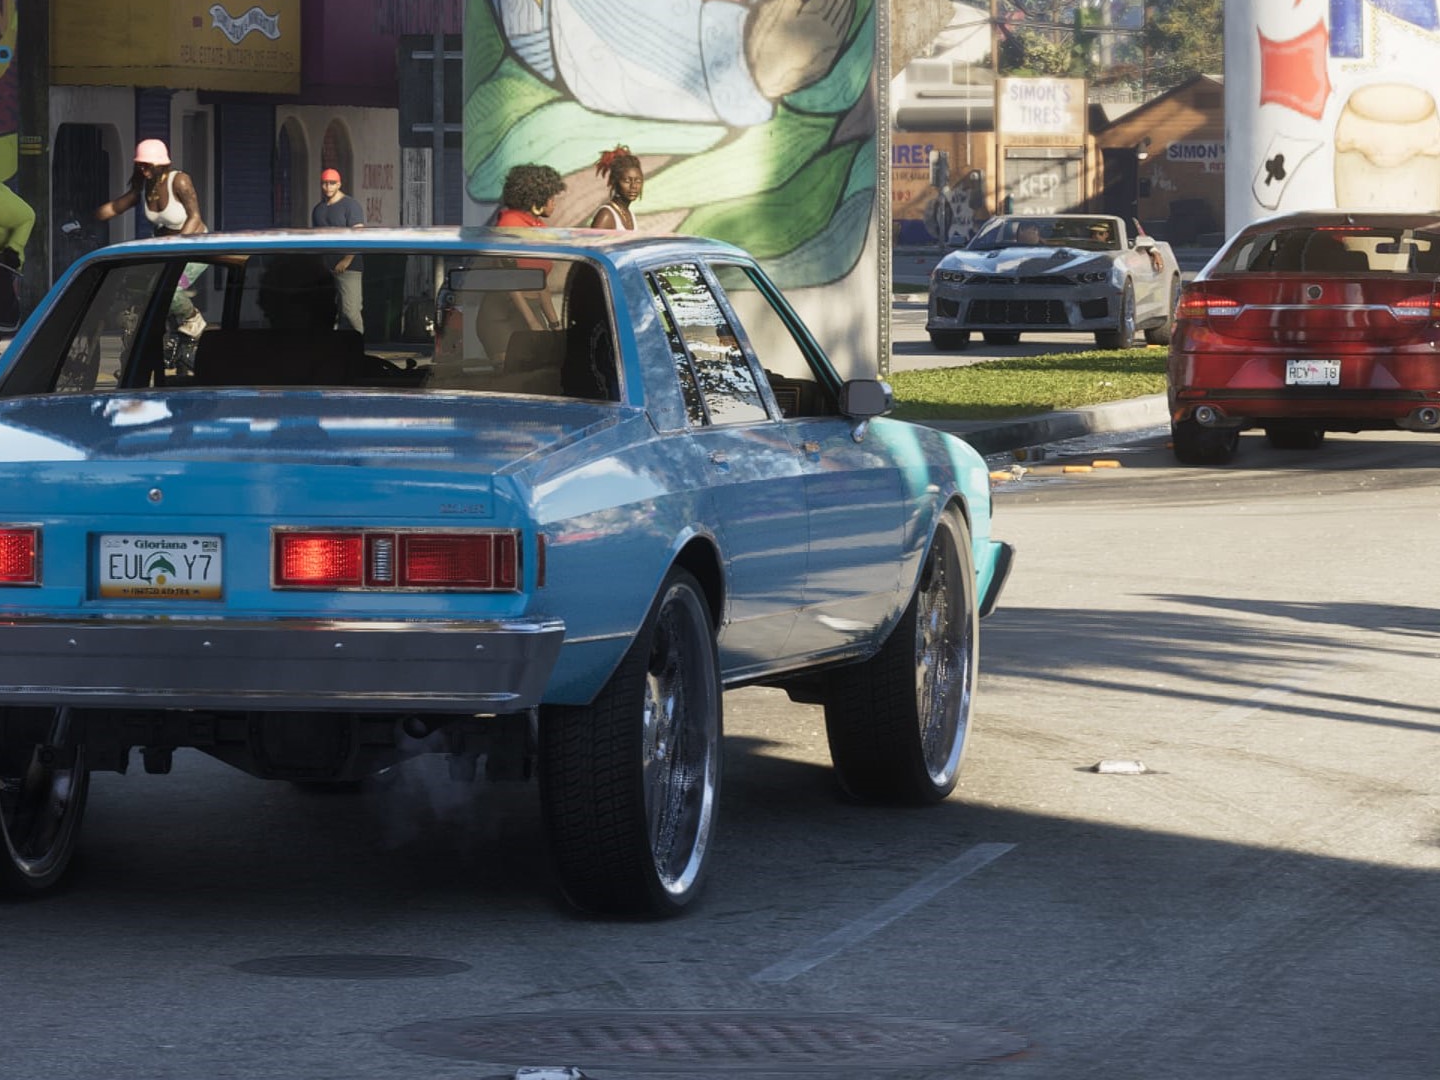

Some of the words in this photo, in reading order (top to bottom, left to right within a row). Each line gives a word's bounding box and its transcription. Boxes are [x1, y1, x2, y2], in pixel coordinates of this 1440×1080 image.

[1010, 84, 1072, 104] SIMON'S
[1019, 105, 1062, 125] TIRES
[892, 144, 934, 164] IRES
[1168, 143, 1225, 159] SIMON'
[1018, 173, 1059, 201] KEEP
[134, 539, 187, 550] Gloriana
[109, 554, 151, 580] EUL
[183, 554, 212, 580] Y7
